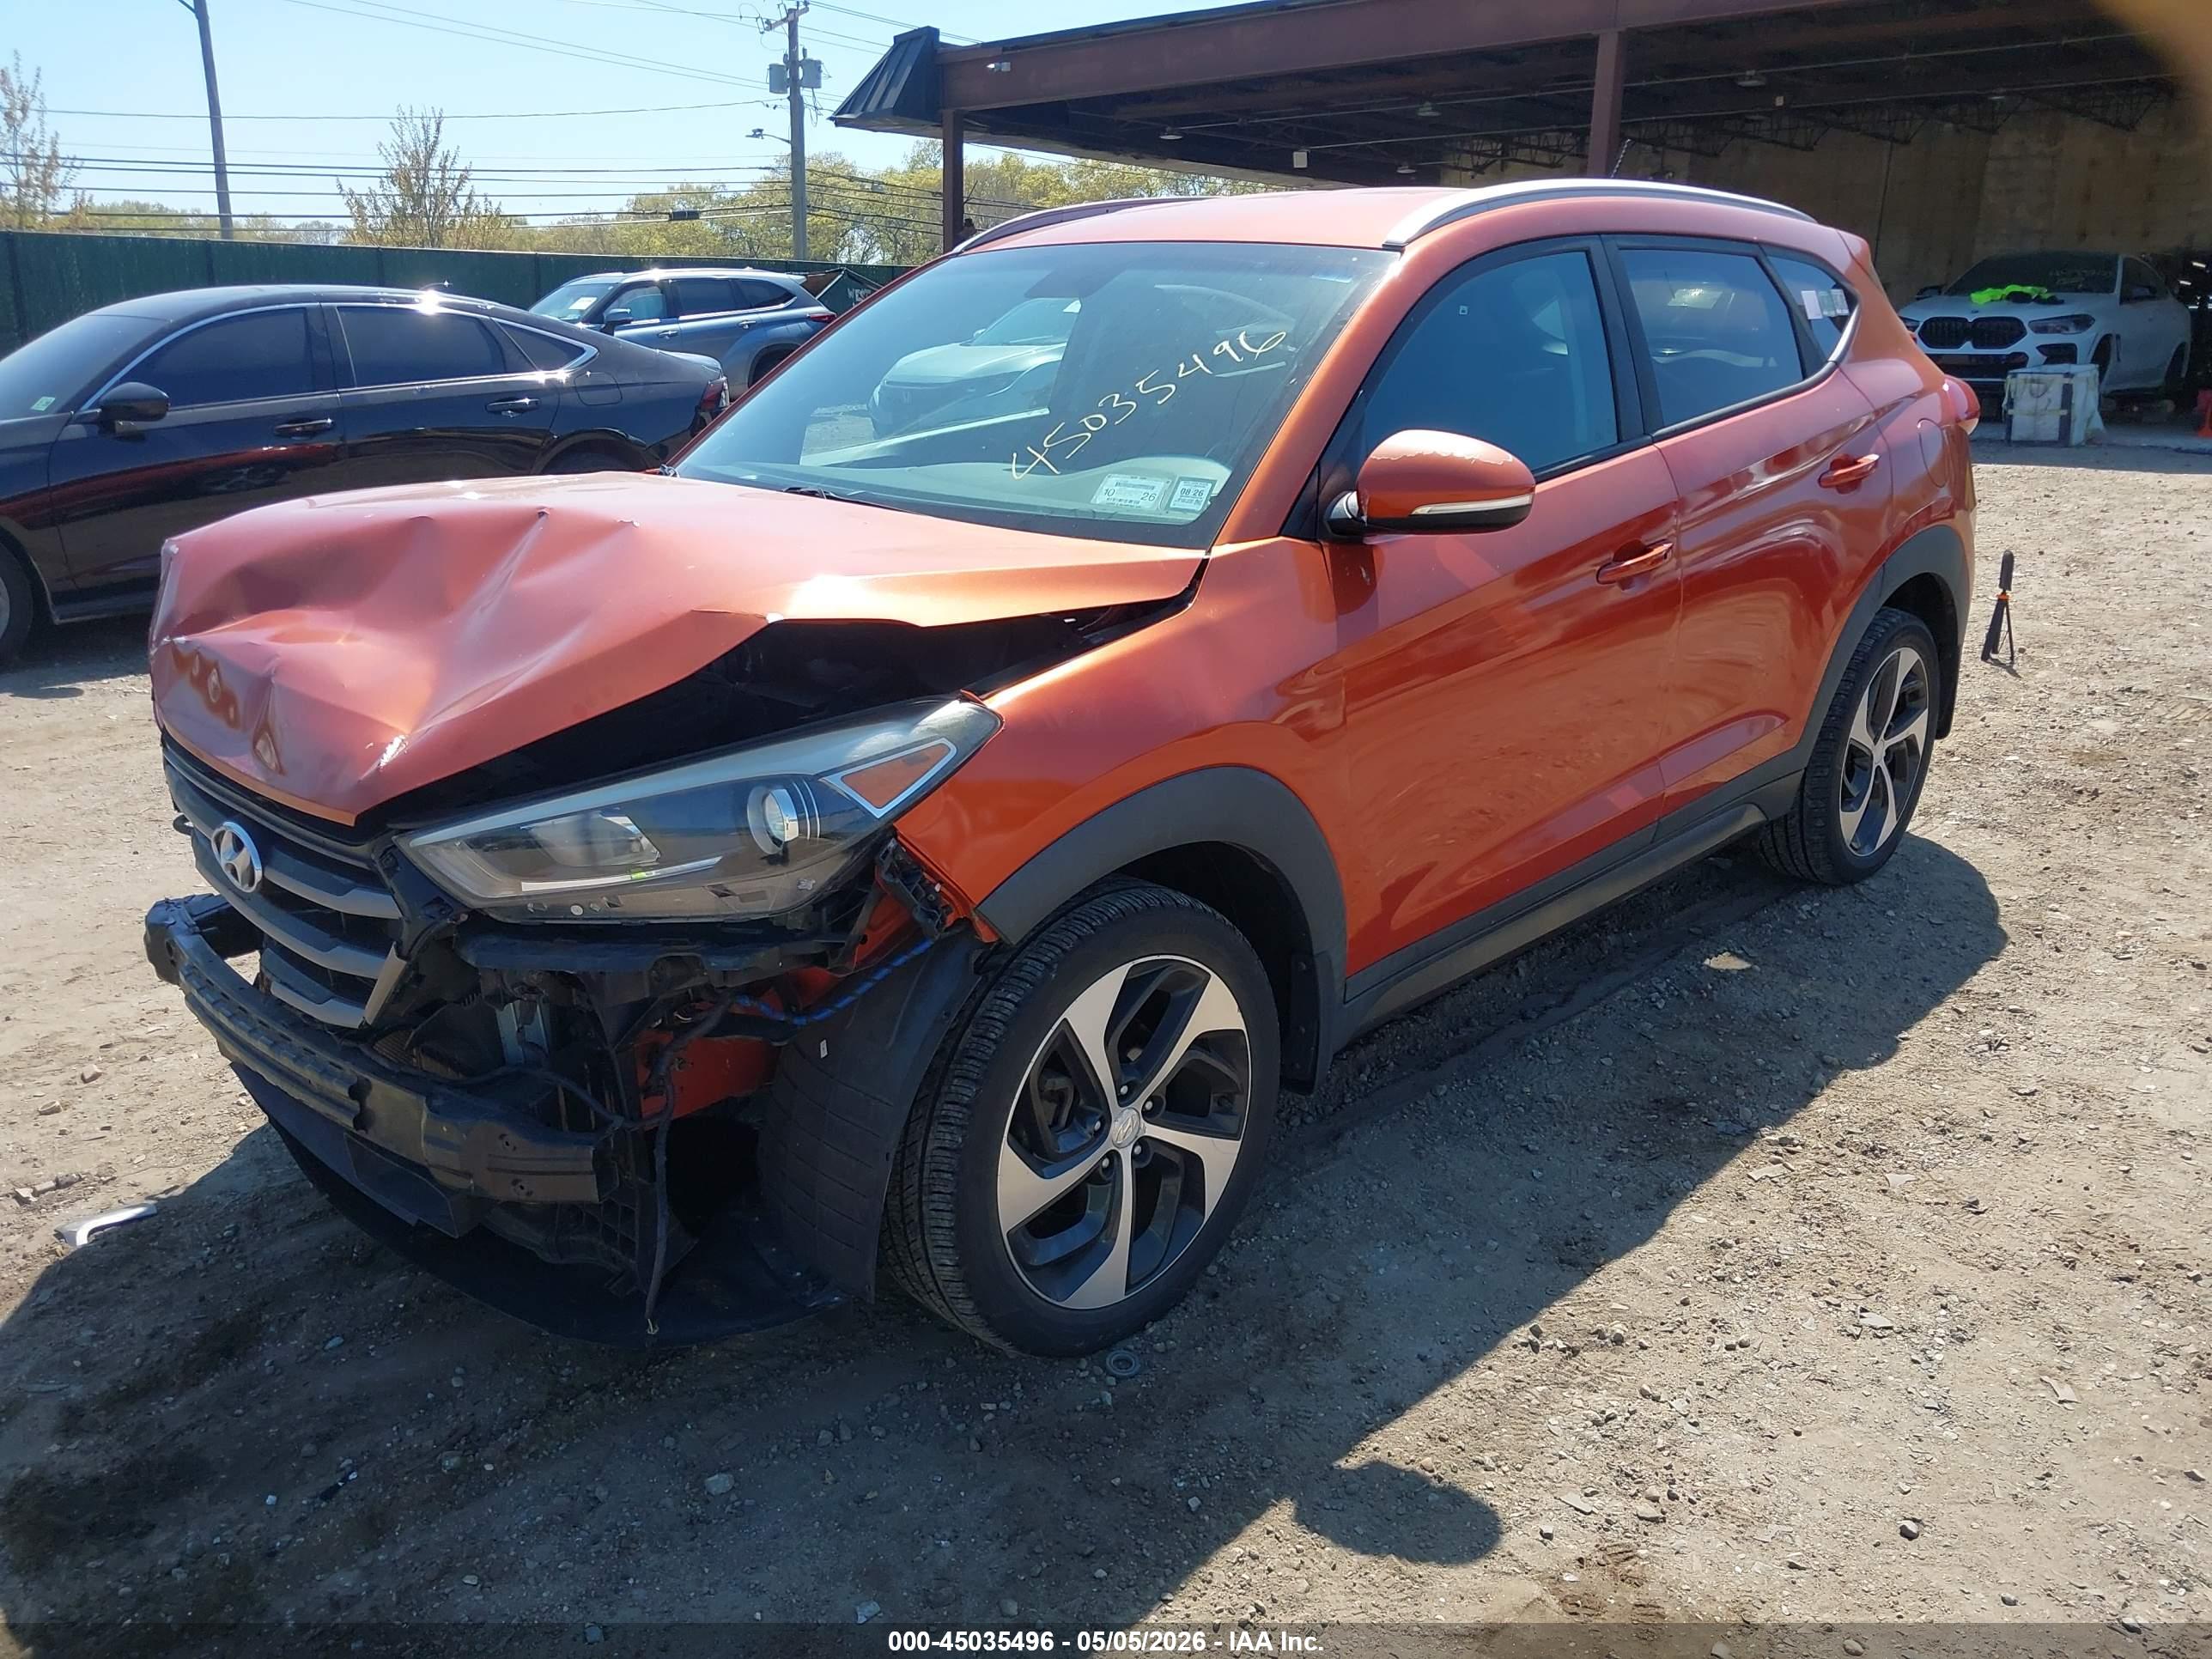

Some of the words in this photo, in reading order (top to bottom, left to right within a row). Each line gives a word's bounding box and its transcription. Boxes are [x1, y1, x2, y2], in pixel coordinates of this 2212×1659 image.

[1012, 331, 1286, 479] 45035496
[1104, 488, 1115, 496] 10
[1140, 492, 1157, 501] 26
